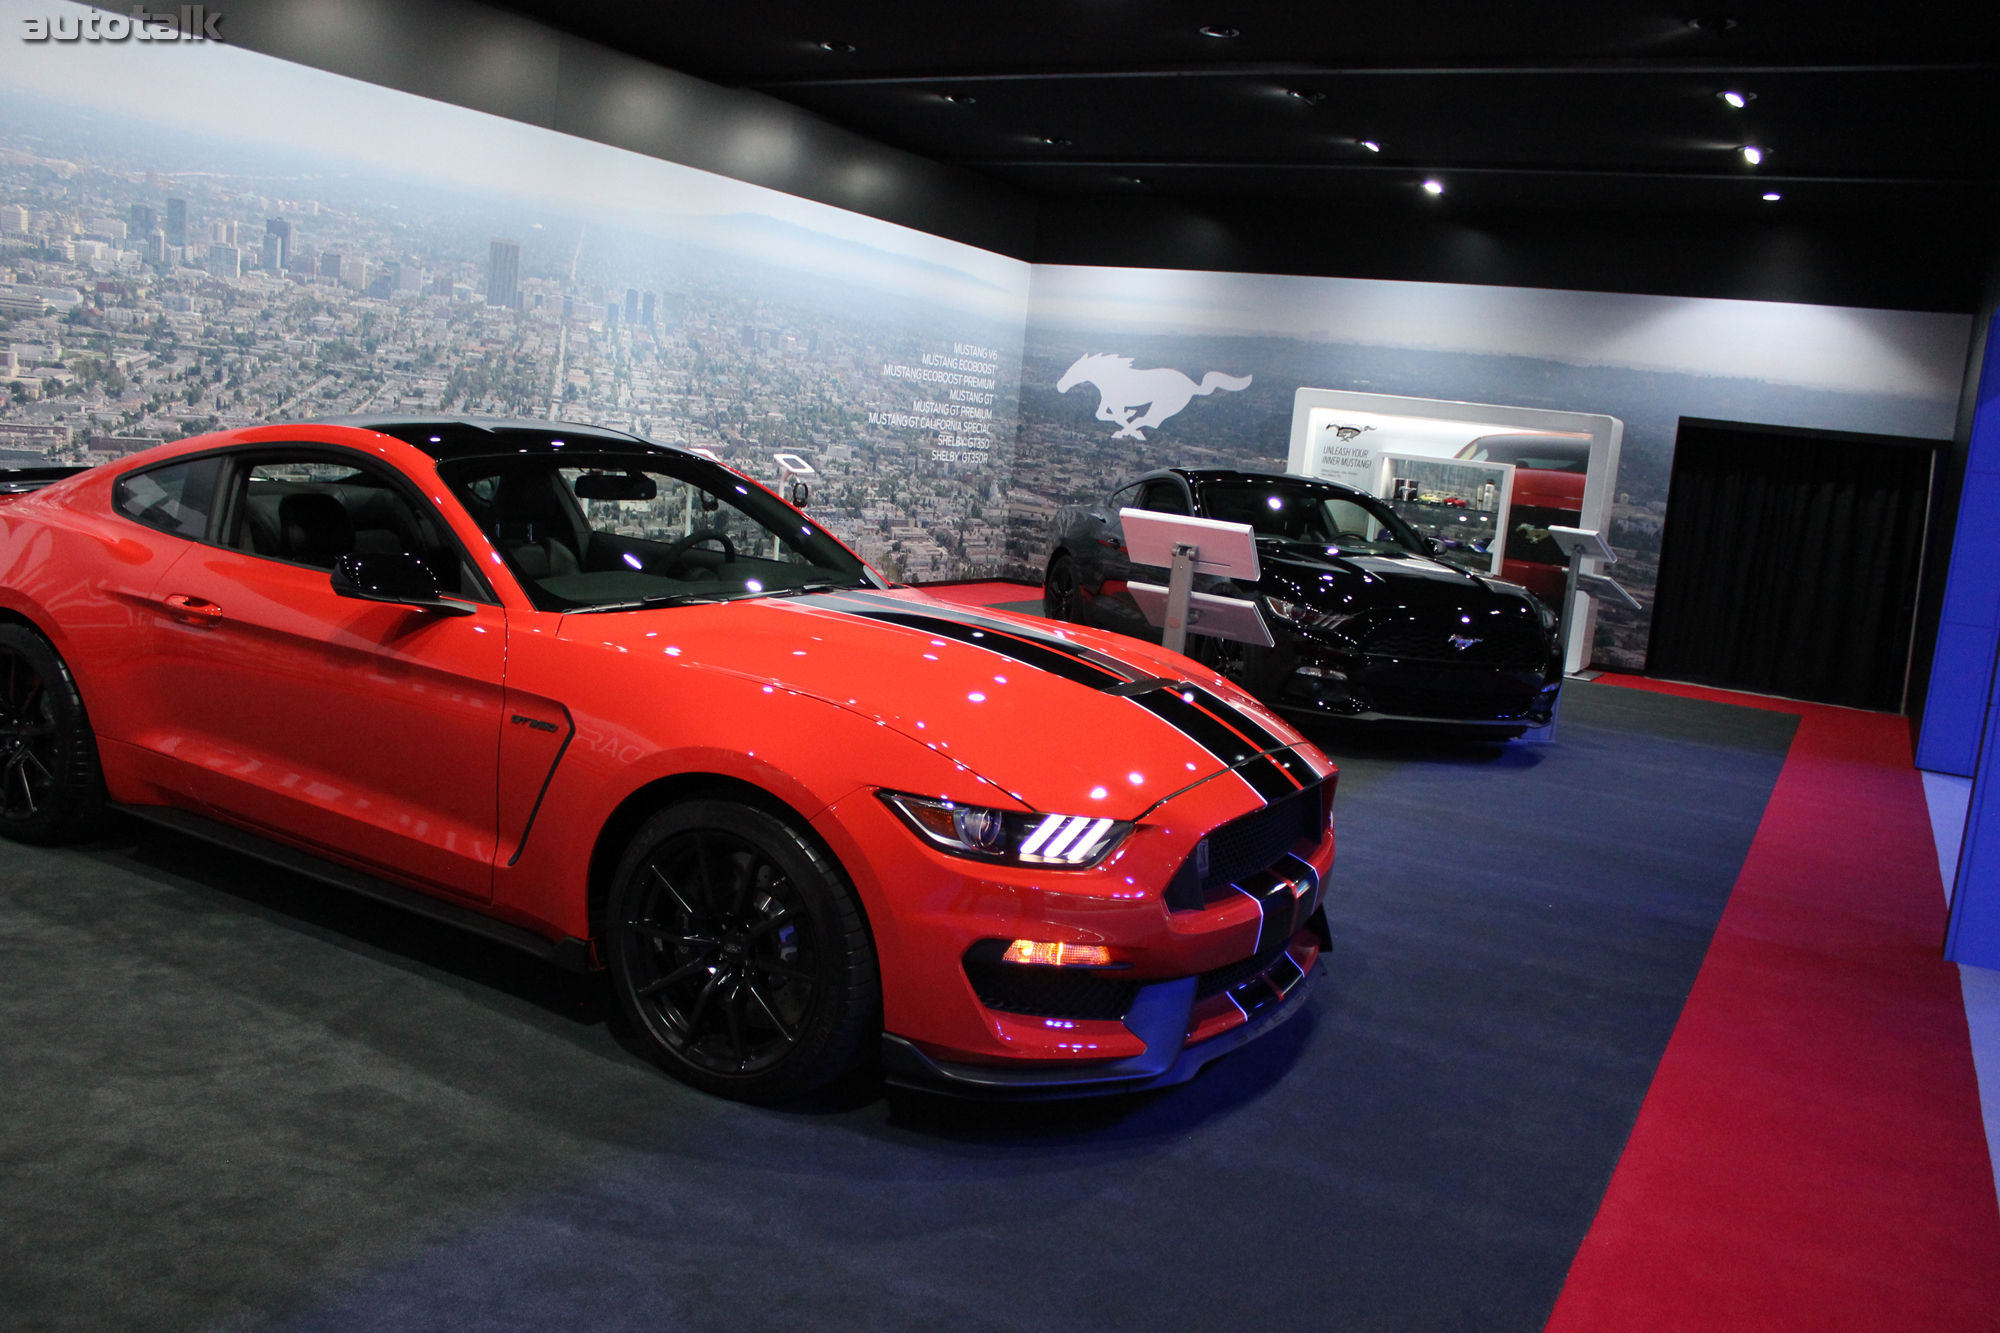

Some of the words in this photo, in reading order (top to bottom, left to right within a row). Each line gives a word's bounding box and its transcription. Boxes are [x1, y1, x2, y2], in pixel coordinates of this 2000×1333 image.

[953, 342, 987, 359] MUSTANG
[988, 349, 998, 361] V6
[922, 353, 958, 369] MUSTANG
[959, 358, 996, 375] ECOBOOST
[883, 363, 922, 379] MUSTANG
[923, 369, 963, 385] ECOBOOST
[963, 375, 995, 390] PREMIUM
[950, 388, 983, 404] MUSTANG
[984, 393, 994, 405] GT
[913, 400, 949, 415] MUSTANG
[949, 404, 960, 416] GT
[961, 405, 993, 419] PREMIUM
[868, 412, 908, 427] MUSTANG
[908, 416, 920, 428] GT
[920, 417, 962, 431] CALIFORNIA
[963, 421, 991, 434] SPECIAL
[938, 434, 966, 447] SHELBY
[967, 437, 990, 450] GT350
[931, 449, 959, 462] SHELBY
[961, 452, 988, 464] GT350R
[1323, 446, 1351, 456] UNLEASH
[1352, 449, 1369, 458] YOUR
[1322, 456, 1340, 466] INNER
[1341, 459, 1372, 468] MUSTANG!
